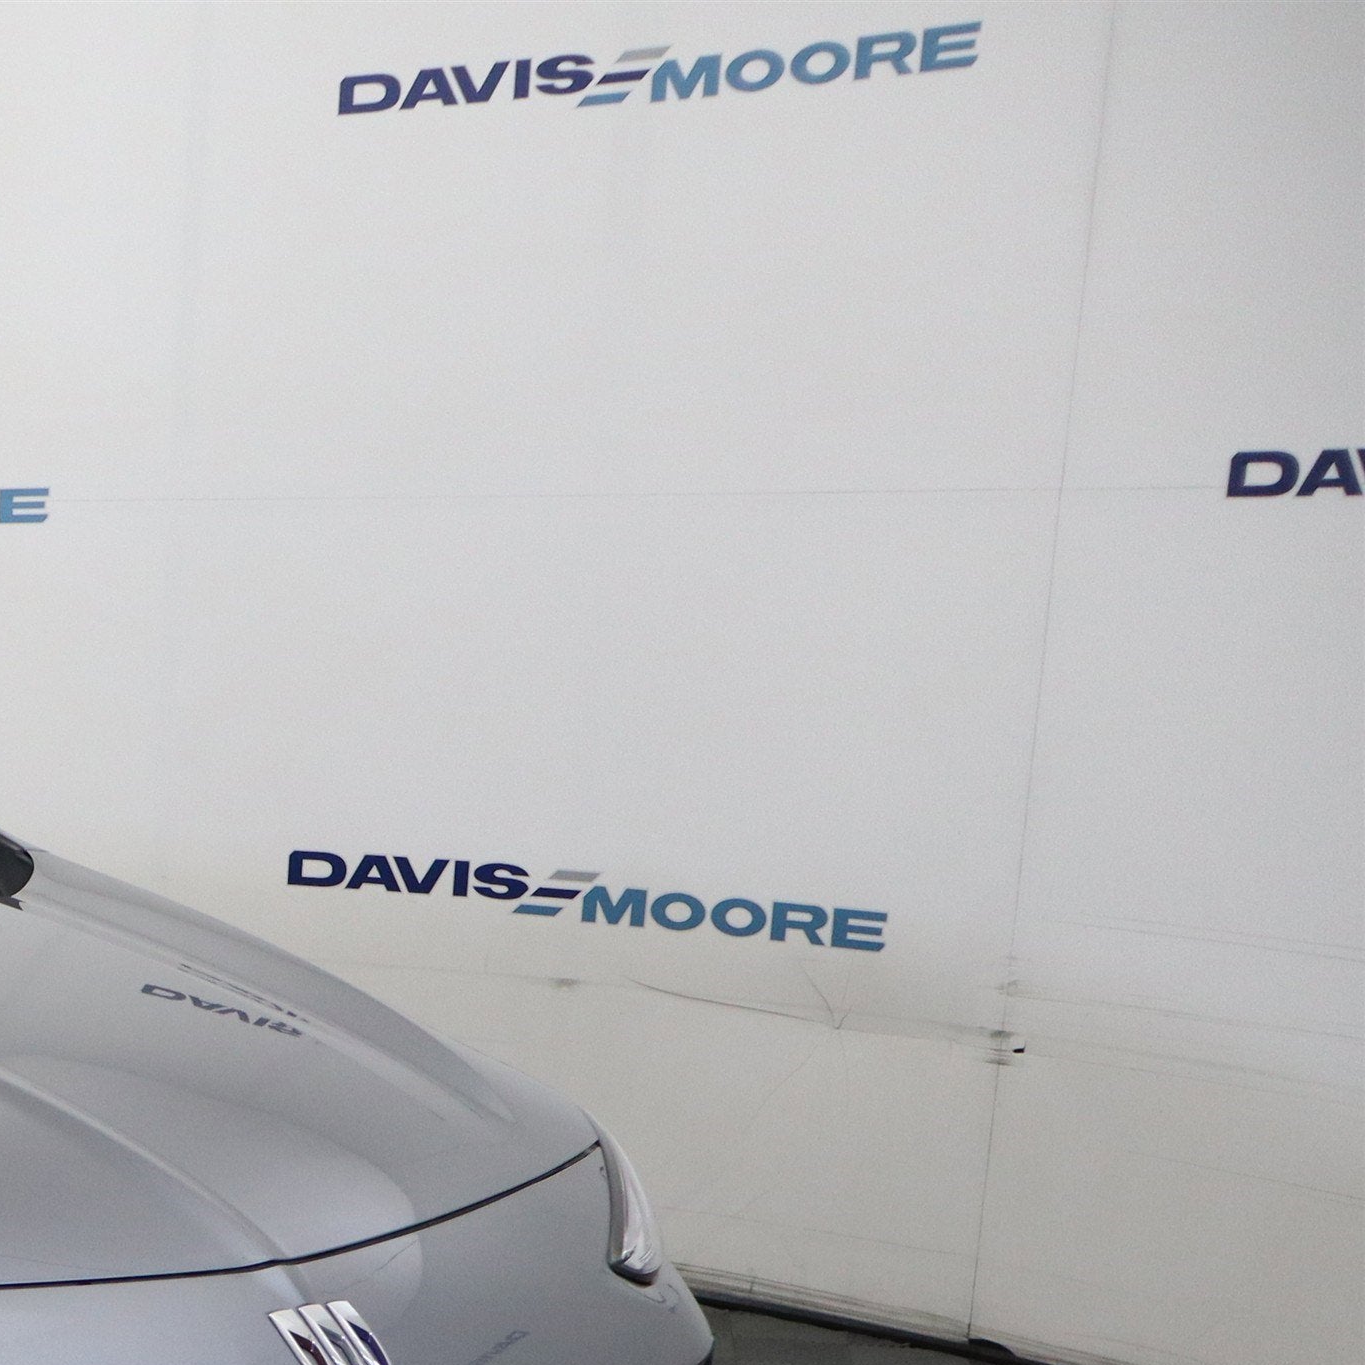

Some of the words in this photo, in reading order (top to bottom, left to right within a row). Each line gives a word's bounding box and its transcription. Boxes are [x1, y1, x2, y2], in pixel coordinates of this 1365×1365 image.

[338, 54, 595, 116] DAVIS
[650, 21, 983, 103] MOORE
[287, 849, 530, 901] DAVIS
[581, 884, 889, 953] MOORE
